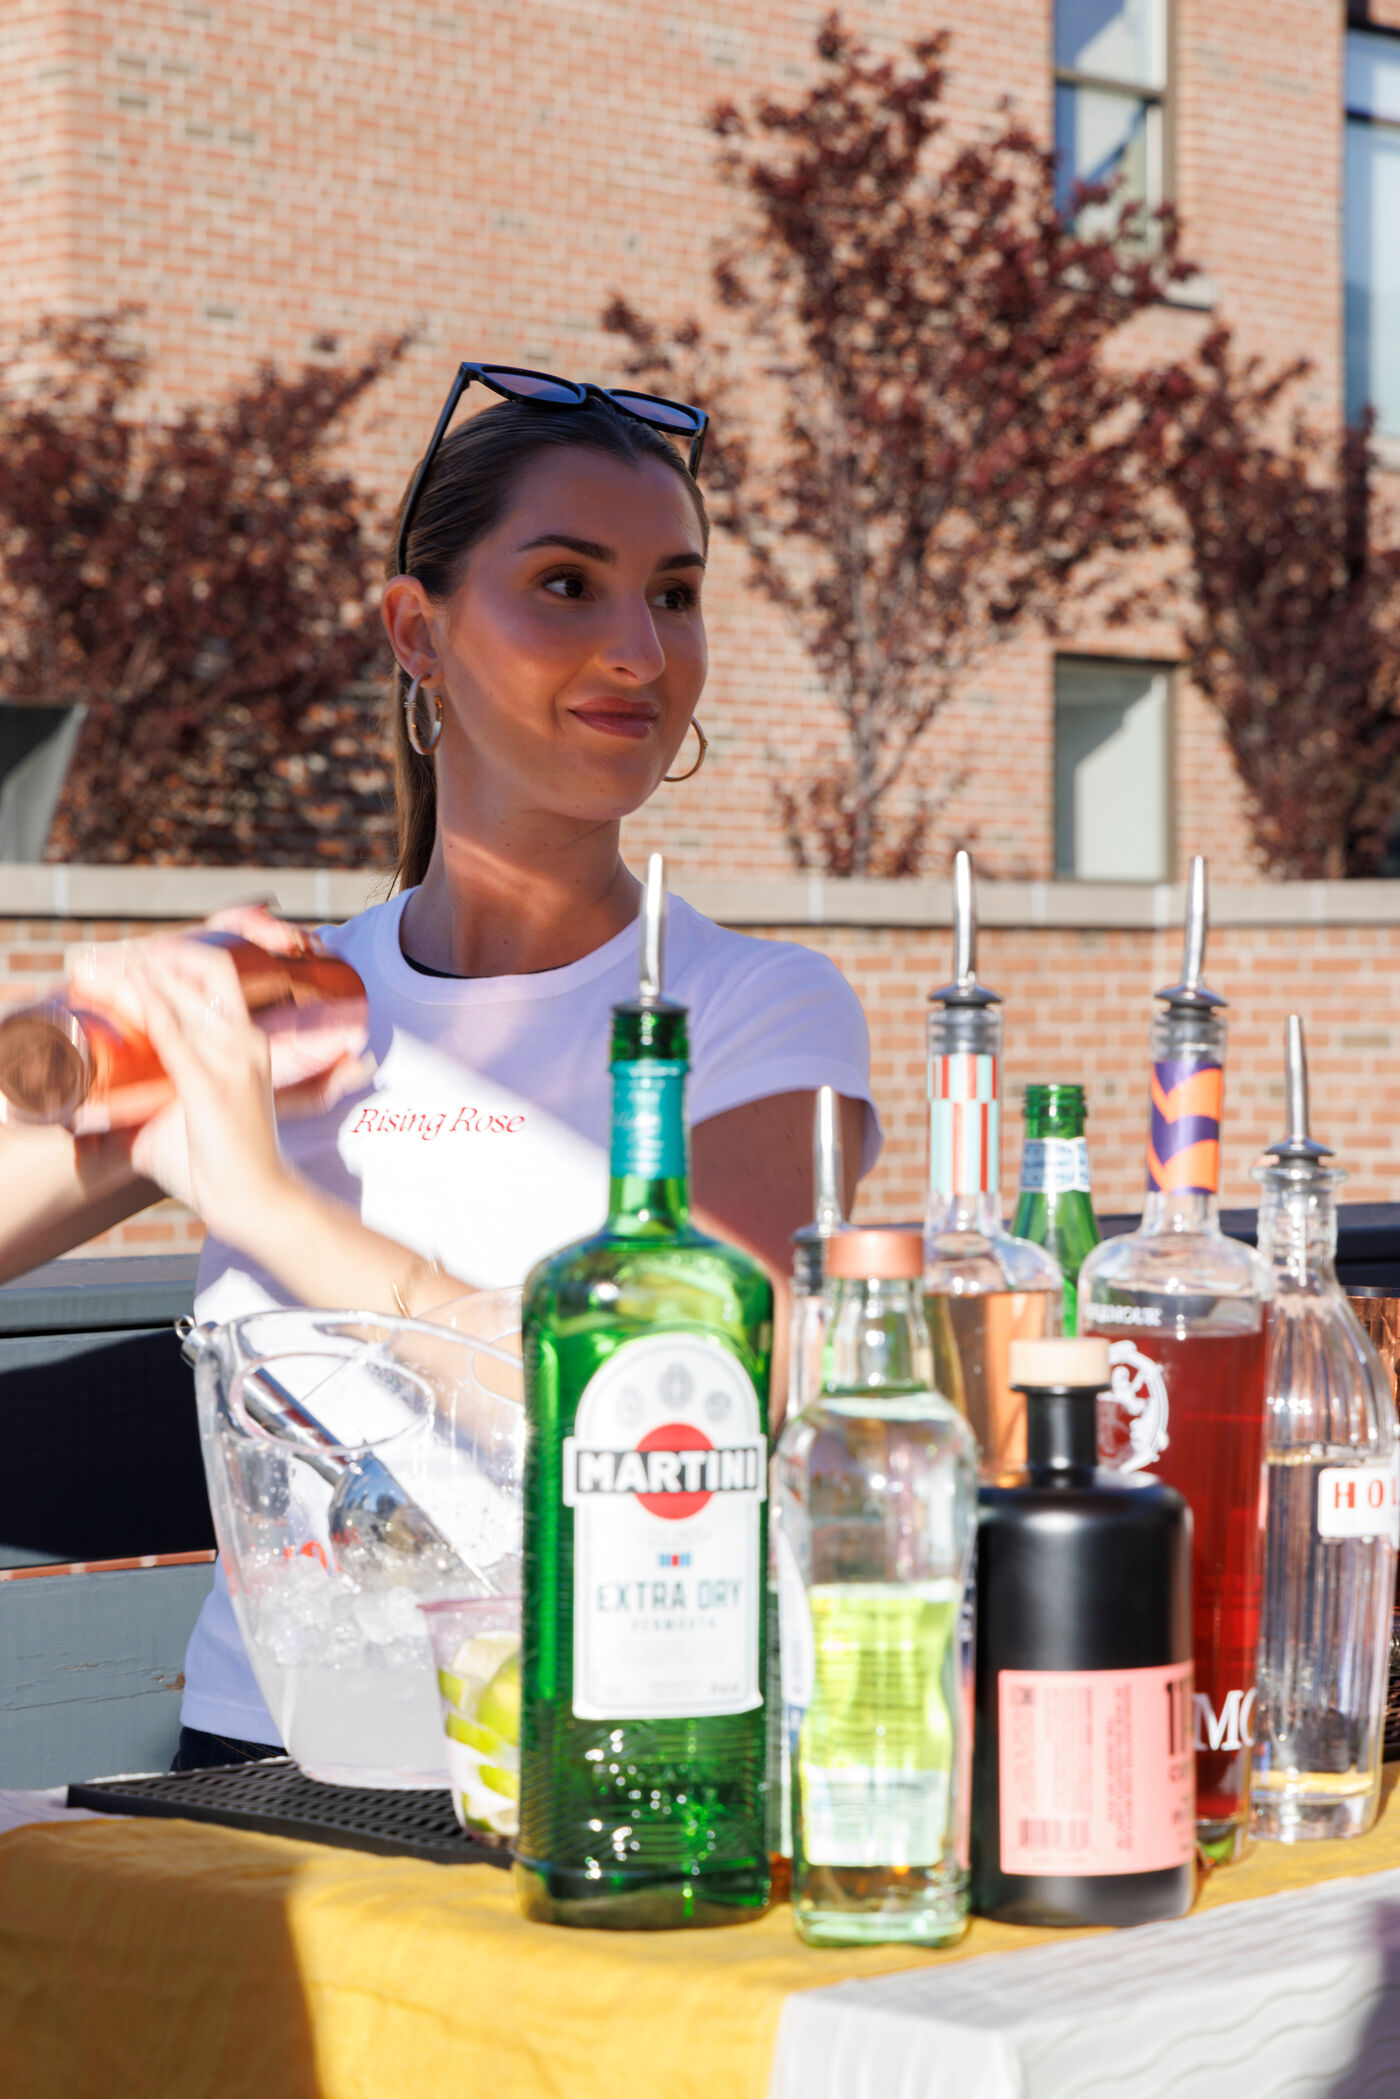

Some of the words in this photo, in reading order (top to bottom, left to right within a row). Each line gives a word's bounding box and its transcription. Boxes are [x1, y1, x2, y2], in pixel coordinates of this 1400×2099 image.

[351, 1108, 447, 1140] Rising
[449, 1107, 525, 1133] Rose
[578, 1449, 757, 1493] MARTINI
[597, 1579, 686, 1611] EXTRA
[697, 1578, 743, 1610] DRY
